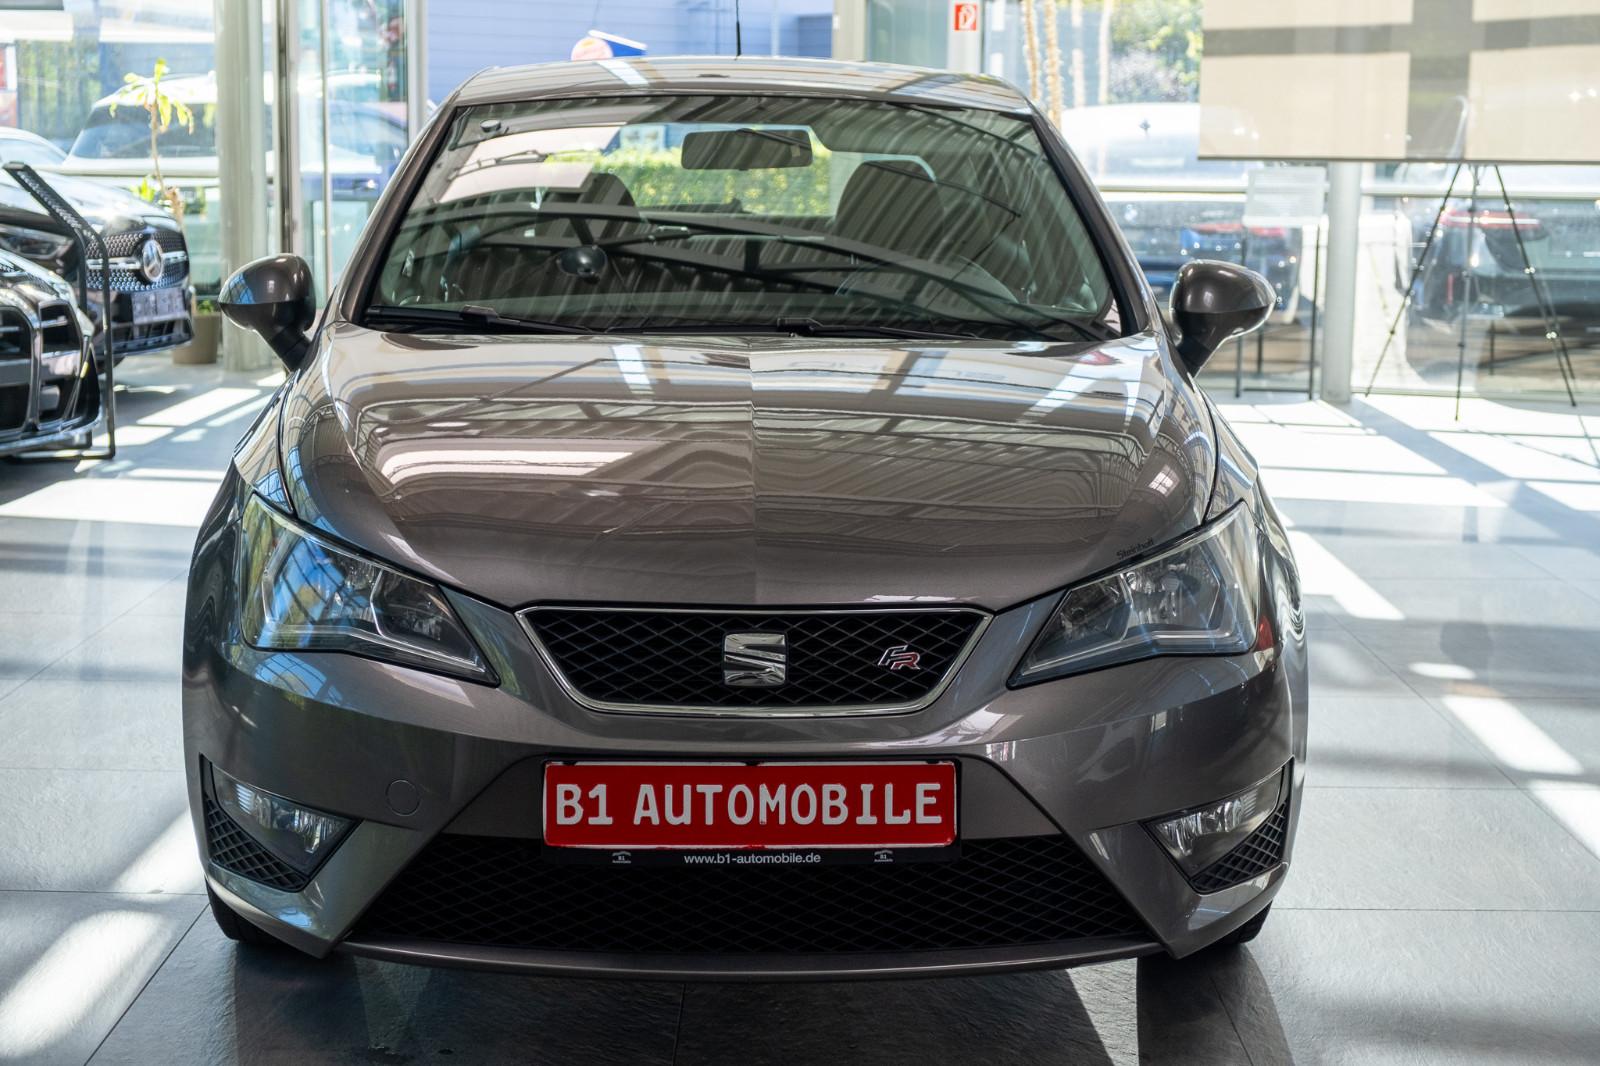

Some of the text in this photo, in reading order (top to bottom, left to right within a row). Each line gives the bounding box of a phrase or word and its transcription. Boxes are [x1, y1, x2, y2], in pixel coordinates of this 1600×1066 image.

[878, 644, 921, 670] FR
[556, 782, 943, 826] B1 AUTOMOBILE
[684, 853, 821, 864] www.b1-automobile.de
